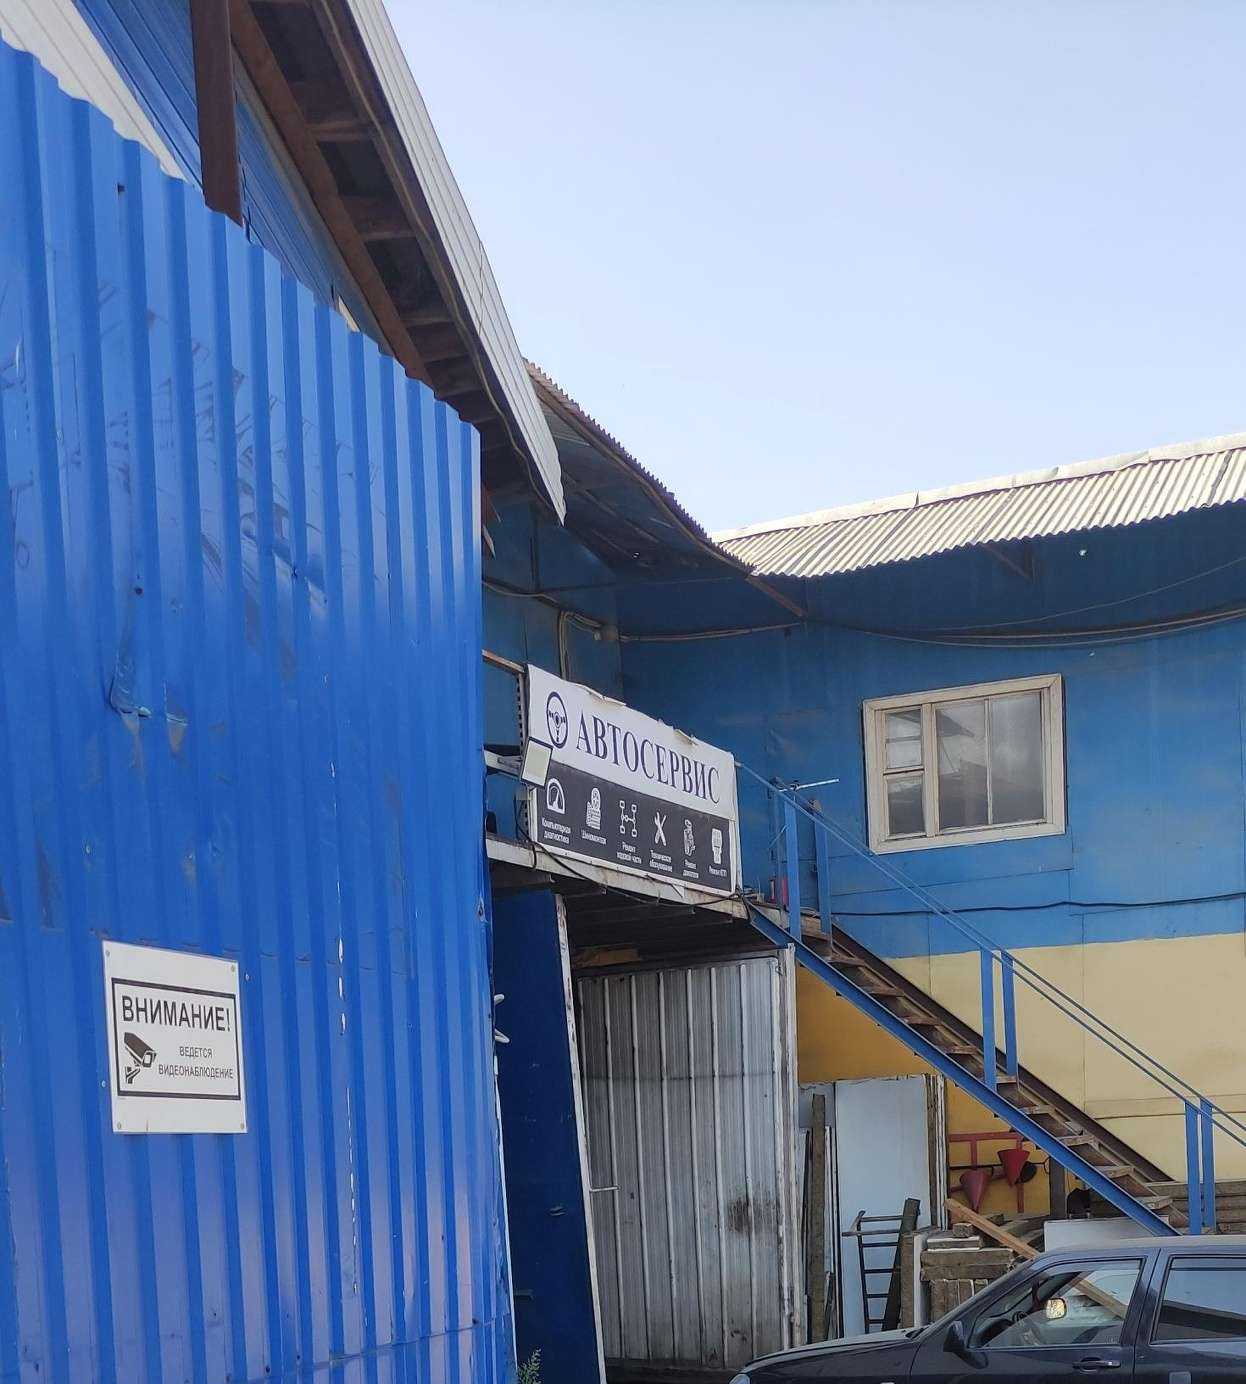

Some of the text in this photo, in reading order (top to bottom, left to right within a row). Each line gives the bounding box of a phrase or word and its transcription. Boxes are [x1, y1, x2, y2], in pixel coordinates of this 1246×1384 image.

[576, 711, 720, 805] АВТОСЕРВИС
[541, 816, 571, 835] Компьютерная
[581, 829, 607, 845] Шиномонтаж
[121, 994, 232, 1032] ВНИМАНИЕ!
[179, 1045, 213, 1059] ВЕДЕТСЯ
[158, 1064, 234, 1080] ВИДЕОНАБЛЮДЕНИЕ
